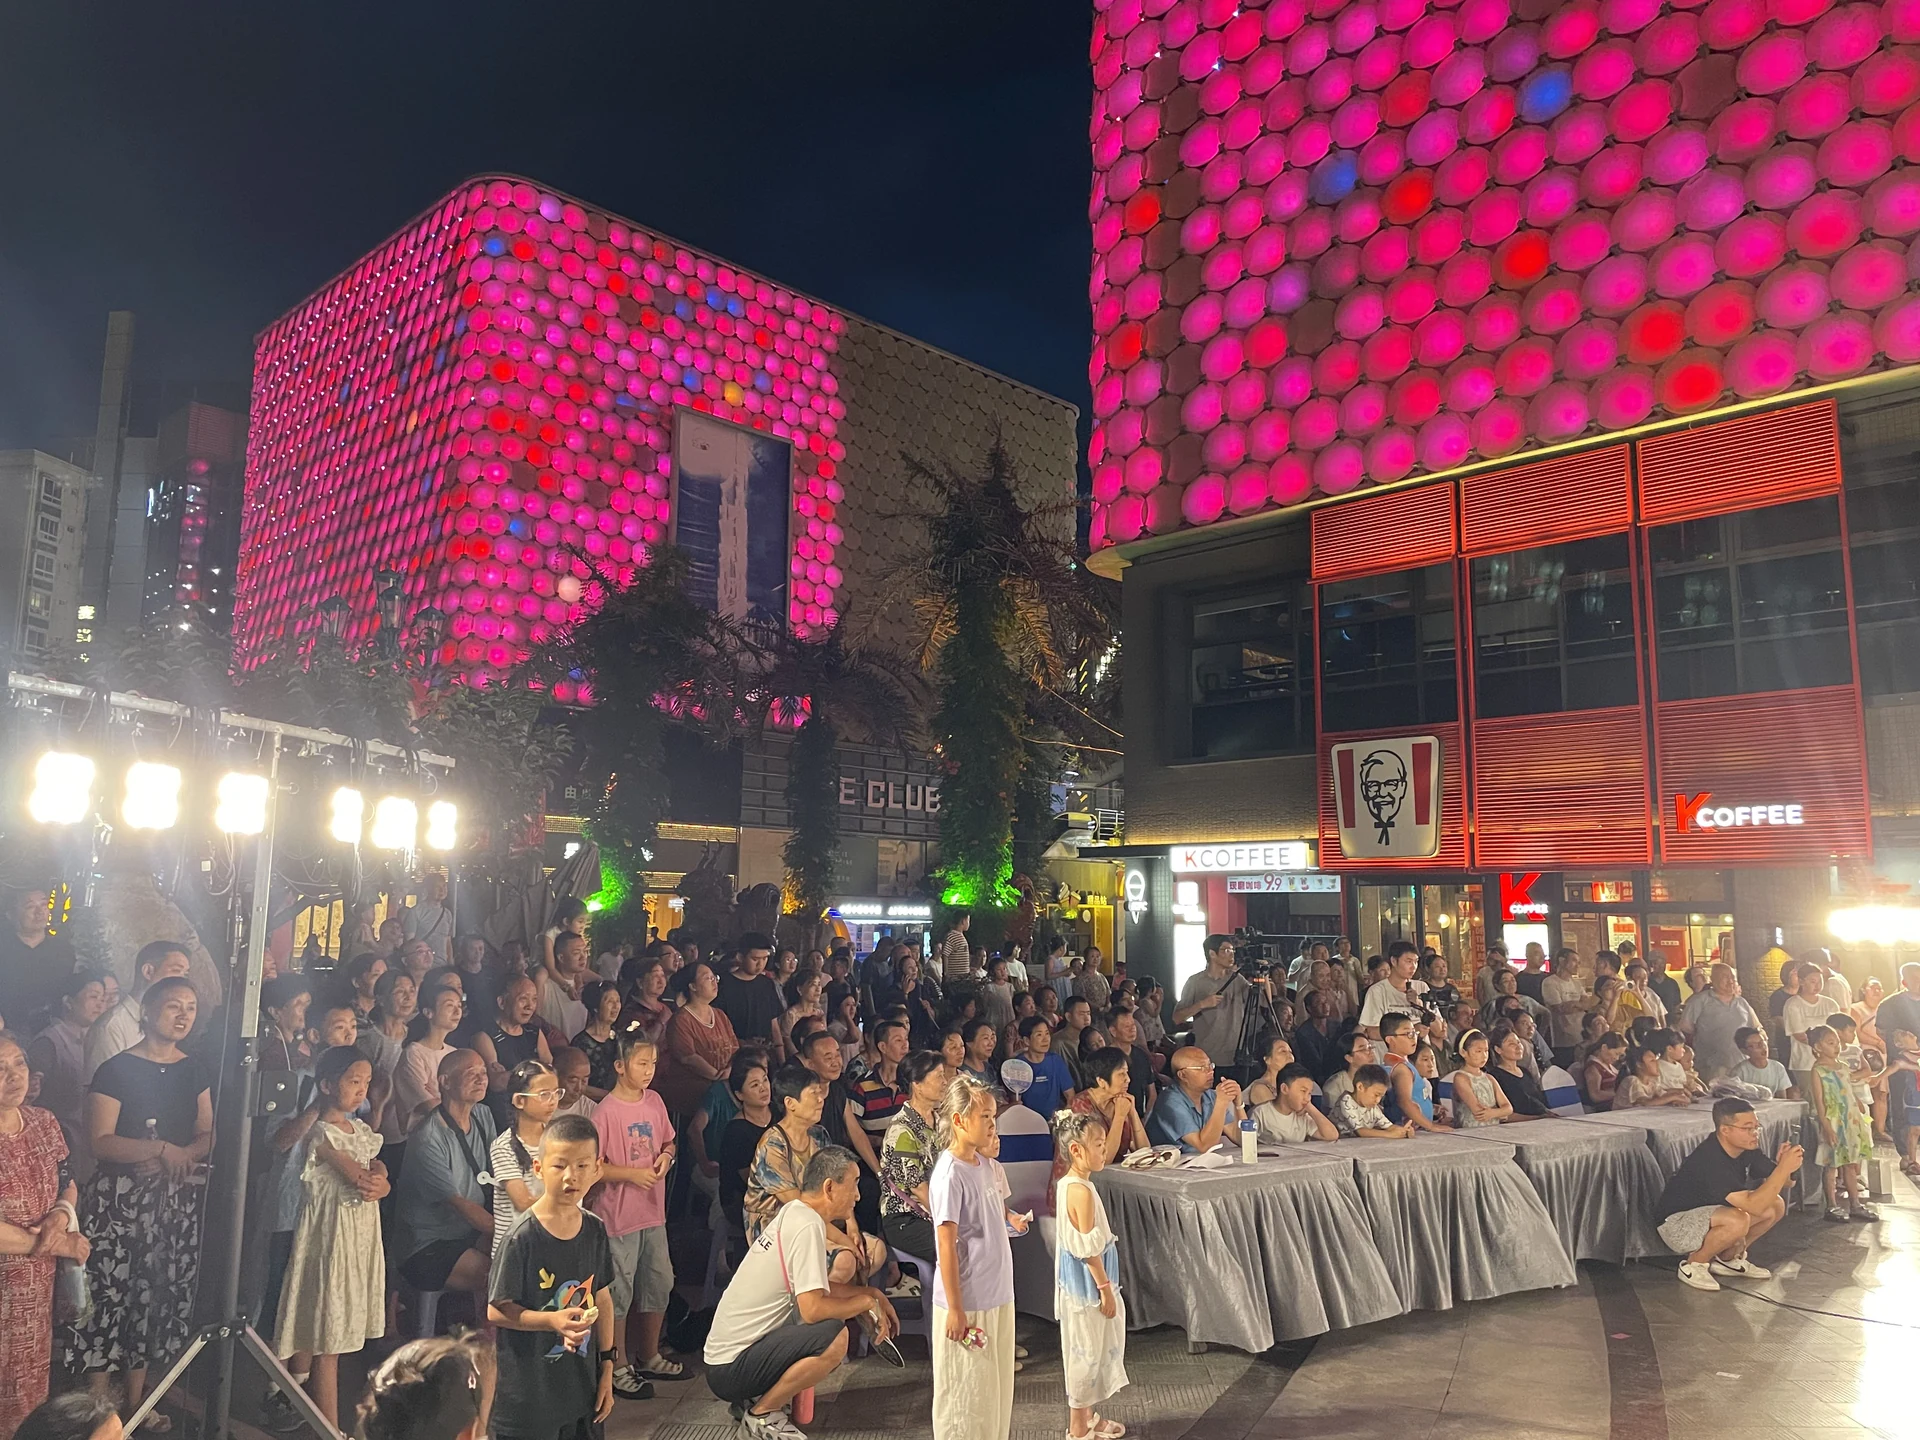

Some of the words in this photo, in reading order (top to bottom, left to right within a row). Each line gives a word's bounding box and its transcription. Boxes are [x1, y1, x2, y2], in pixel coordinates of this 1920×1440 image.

[867, 779, 941, 812] CLUB
[1185, 847, 1291, 868] KCOFFEE
[1263, 873, 1282, 891] 9.9
